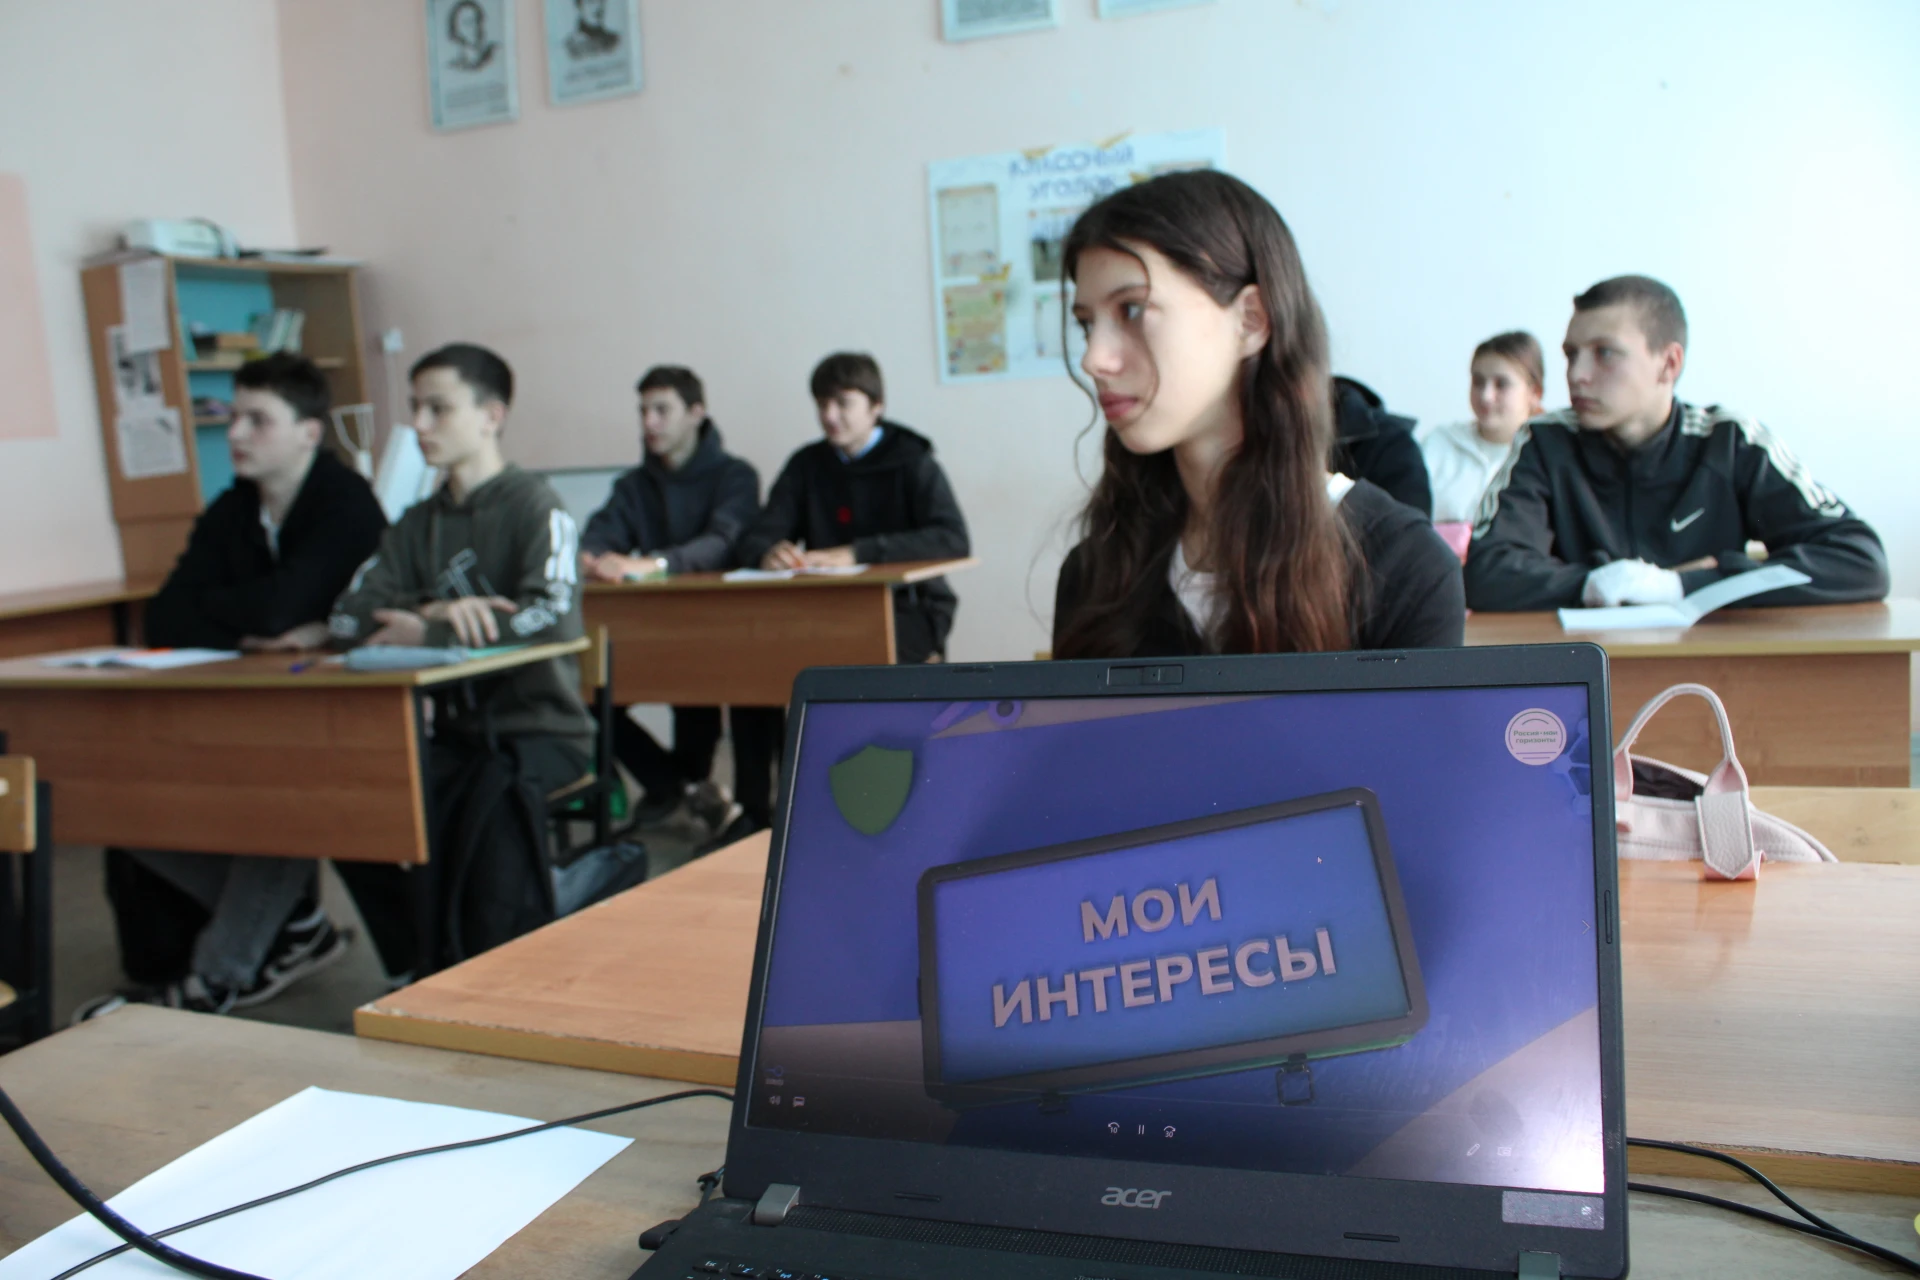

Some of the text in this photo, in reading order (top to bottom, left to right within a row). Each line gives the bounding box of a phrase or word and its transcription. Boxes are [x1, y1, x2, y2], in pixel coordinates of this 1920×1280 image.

[1080, 878, 1222, 943] МОИ
[992, 927, 1336, 1028] ИНТЕРЕСЫ
[1101, 1187, 1172, 1209] acer
